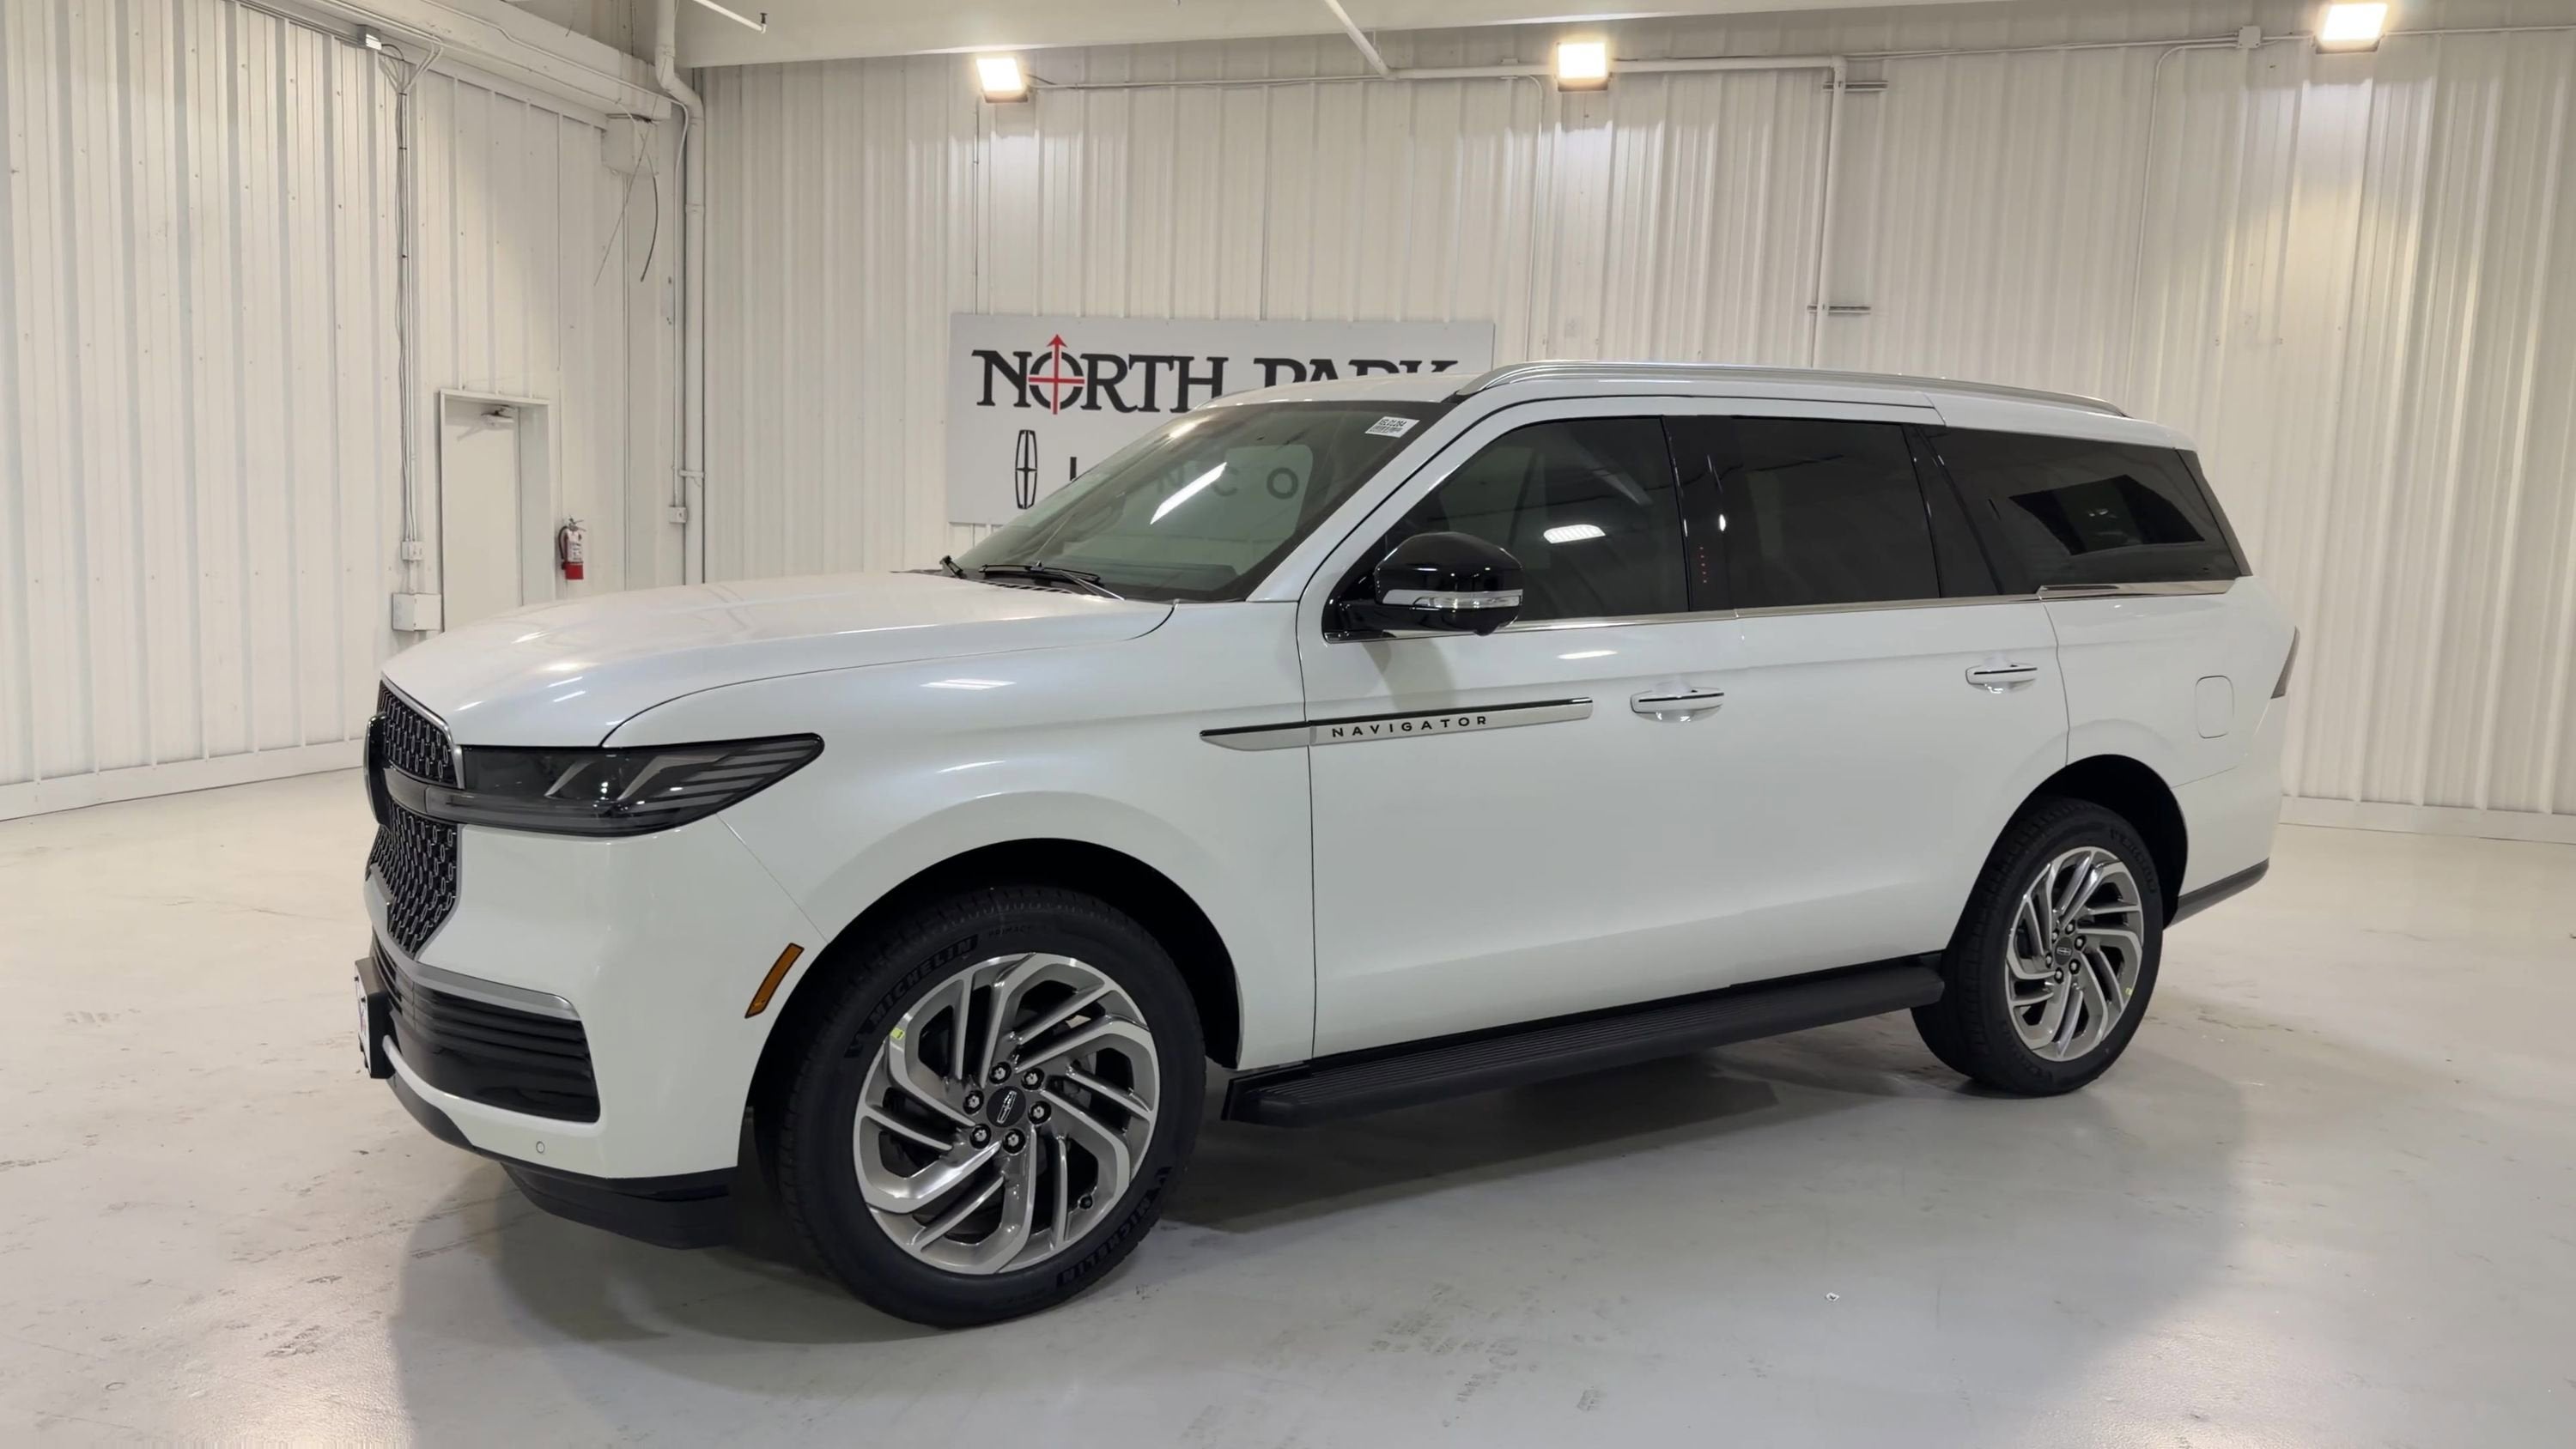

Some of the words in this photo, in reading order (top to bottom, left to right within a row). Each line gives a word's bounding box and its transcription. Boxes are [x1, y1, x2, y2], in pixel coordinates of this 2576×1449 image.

[971, 349, 1229, 413] NORTH
[1332, 716, 1487, 738] NAVIGATOR
[870, 937, 975, 1025] MICHELIN
